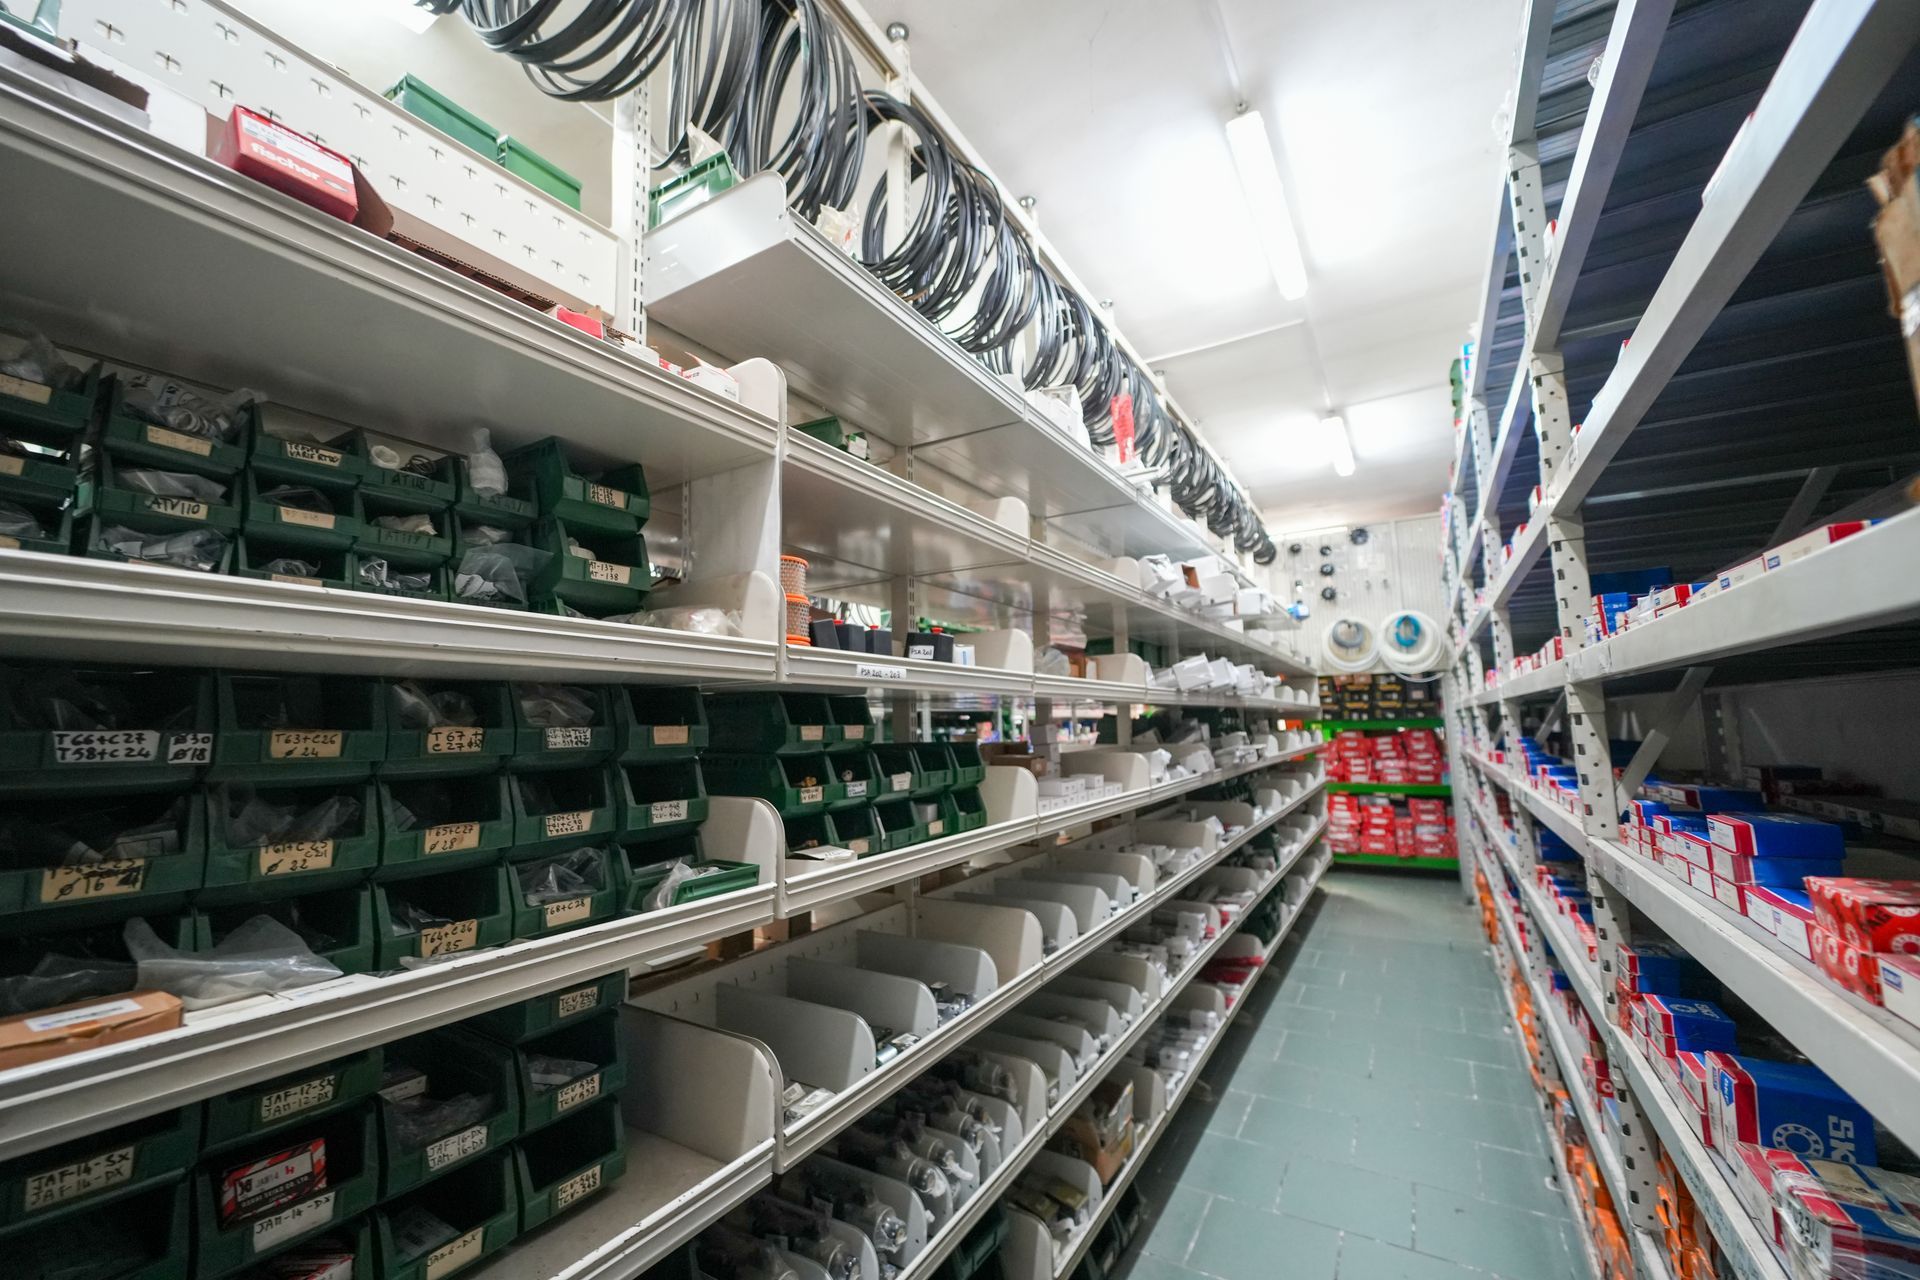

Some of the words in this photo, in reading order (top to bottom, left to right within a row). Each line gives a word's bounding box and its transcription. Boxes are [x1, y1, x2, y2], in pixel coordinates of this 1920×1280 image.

[250, 142, 321, 180] fischer
[446, 730, 465, 742] 67
[1828, 1115, 1858, 1165] SK
